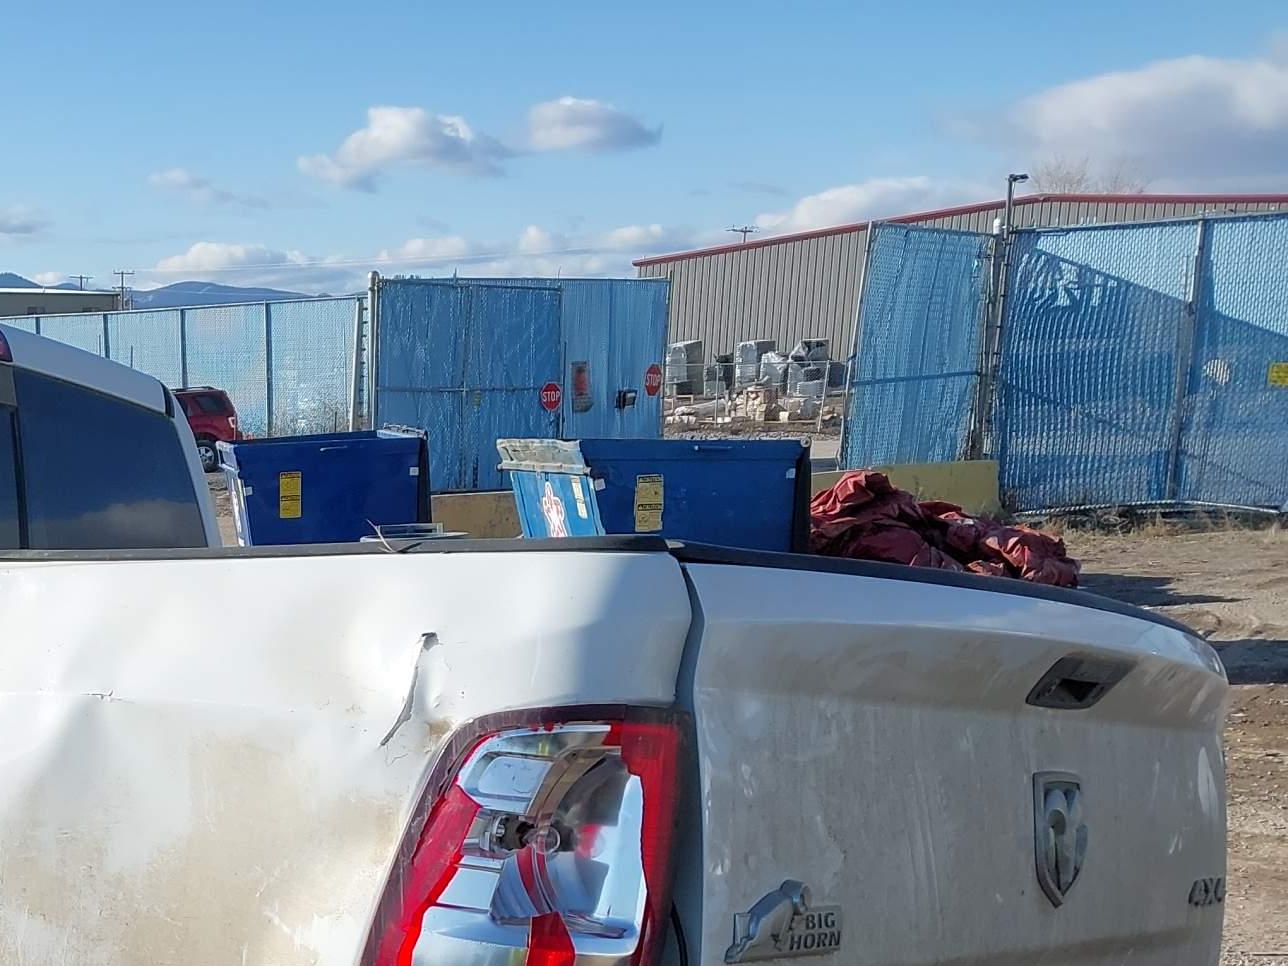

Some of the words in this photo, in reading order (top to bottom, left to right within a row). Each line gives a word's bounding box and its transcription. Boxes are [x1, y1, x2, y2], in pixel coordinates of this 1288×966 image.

[646, 374, 661, 387] STOP
[542, 391, 560, 402] STOP
[805, 912, 835, 930] BIG
[789, 931, 841, 951] HORN
